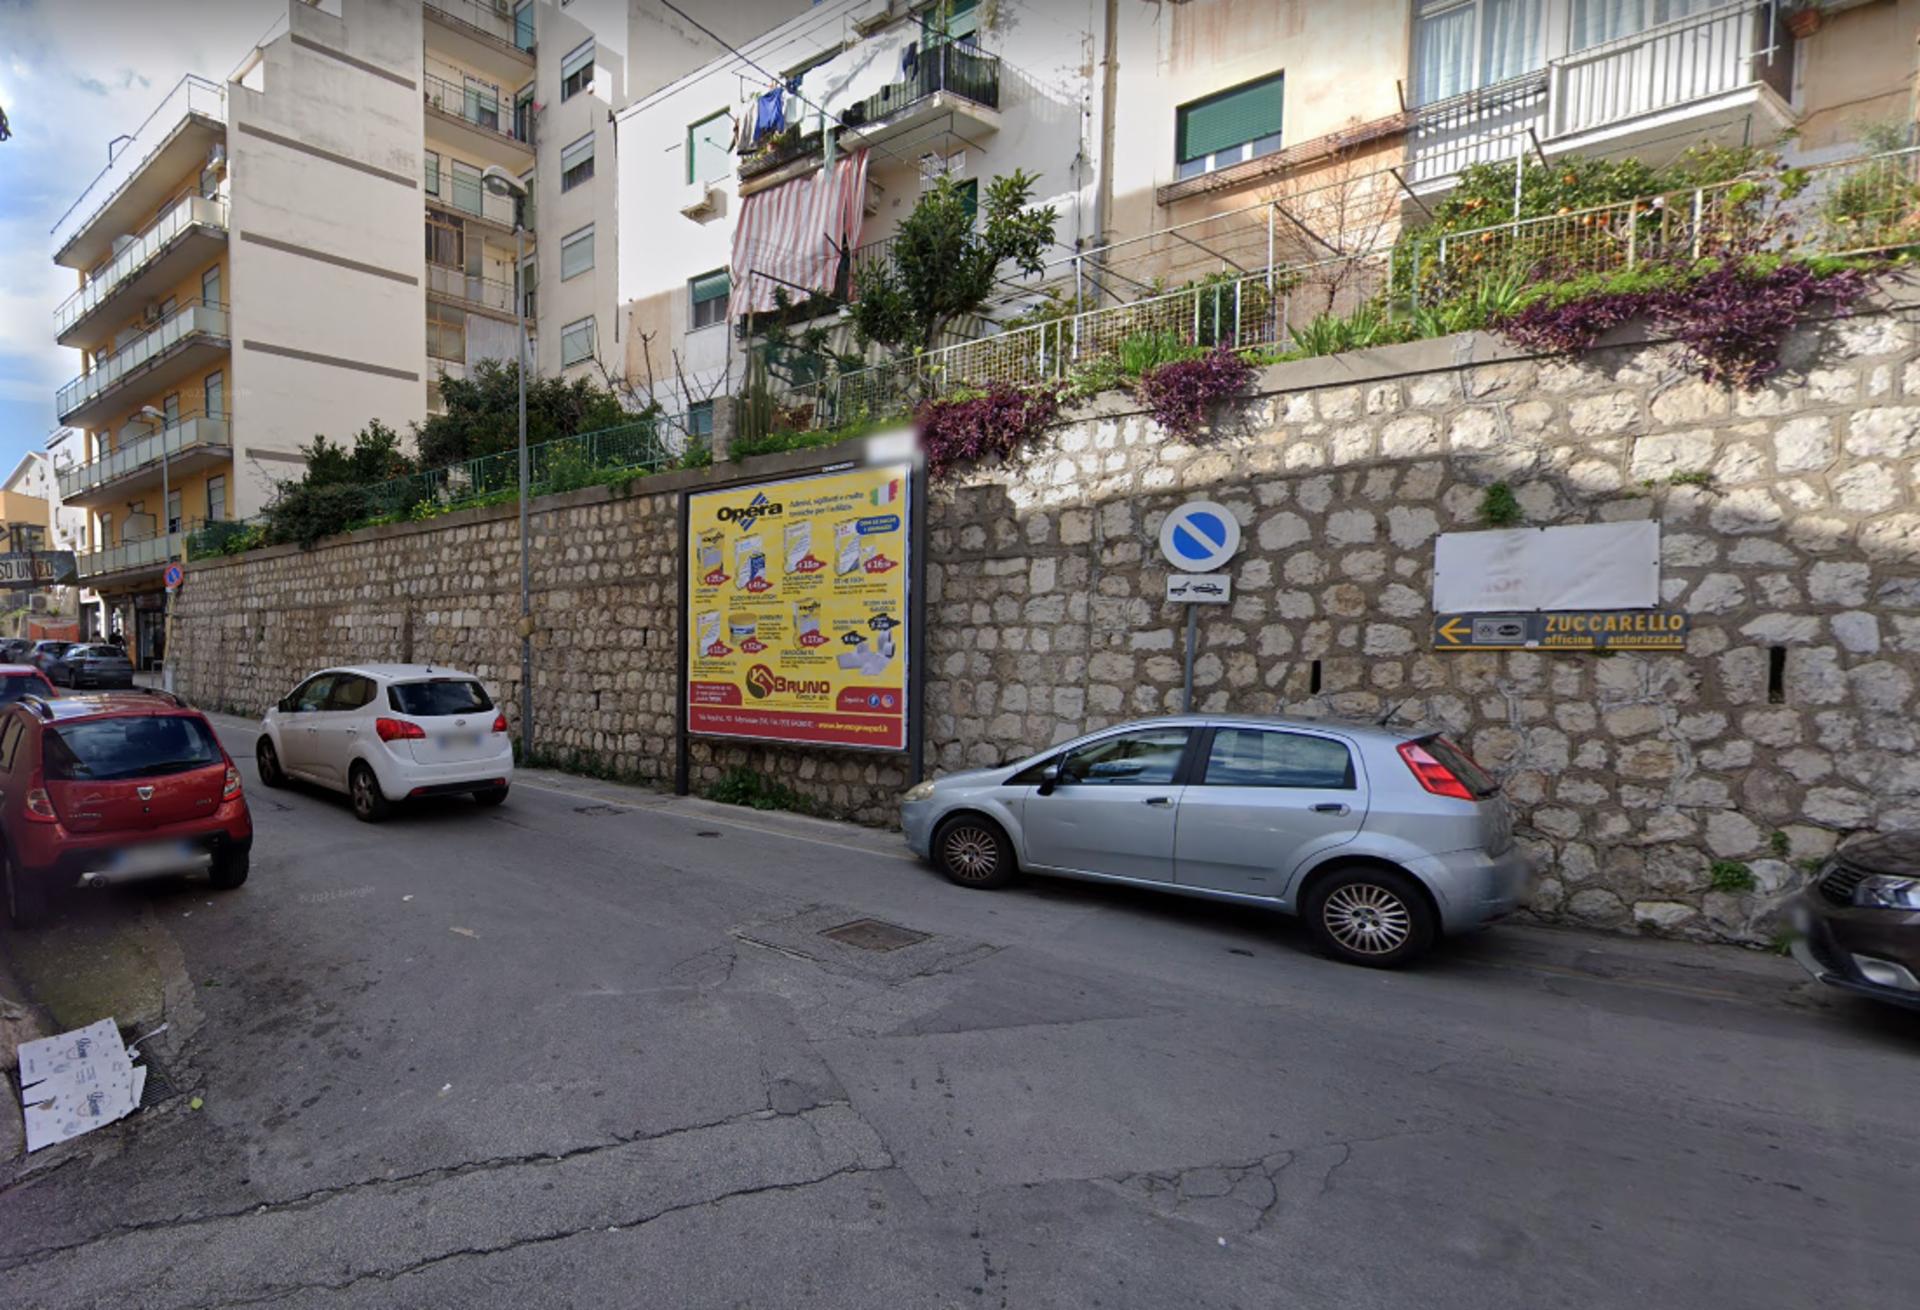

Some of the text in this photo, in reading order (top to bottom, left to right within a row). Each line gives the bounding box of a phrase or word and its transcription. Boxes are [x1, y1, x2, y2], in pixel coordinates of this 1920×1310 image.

[716, 502, 784, 525] Opera
[1545, 614, 1685, 632] ZUCCARELLO
[1544, 633, 1682, 645] officina autorizzata
[774, 676, 831, 695] BRUNO
